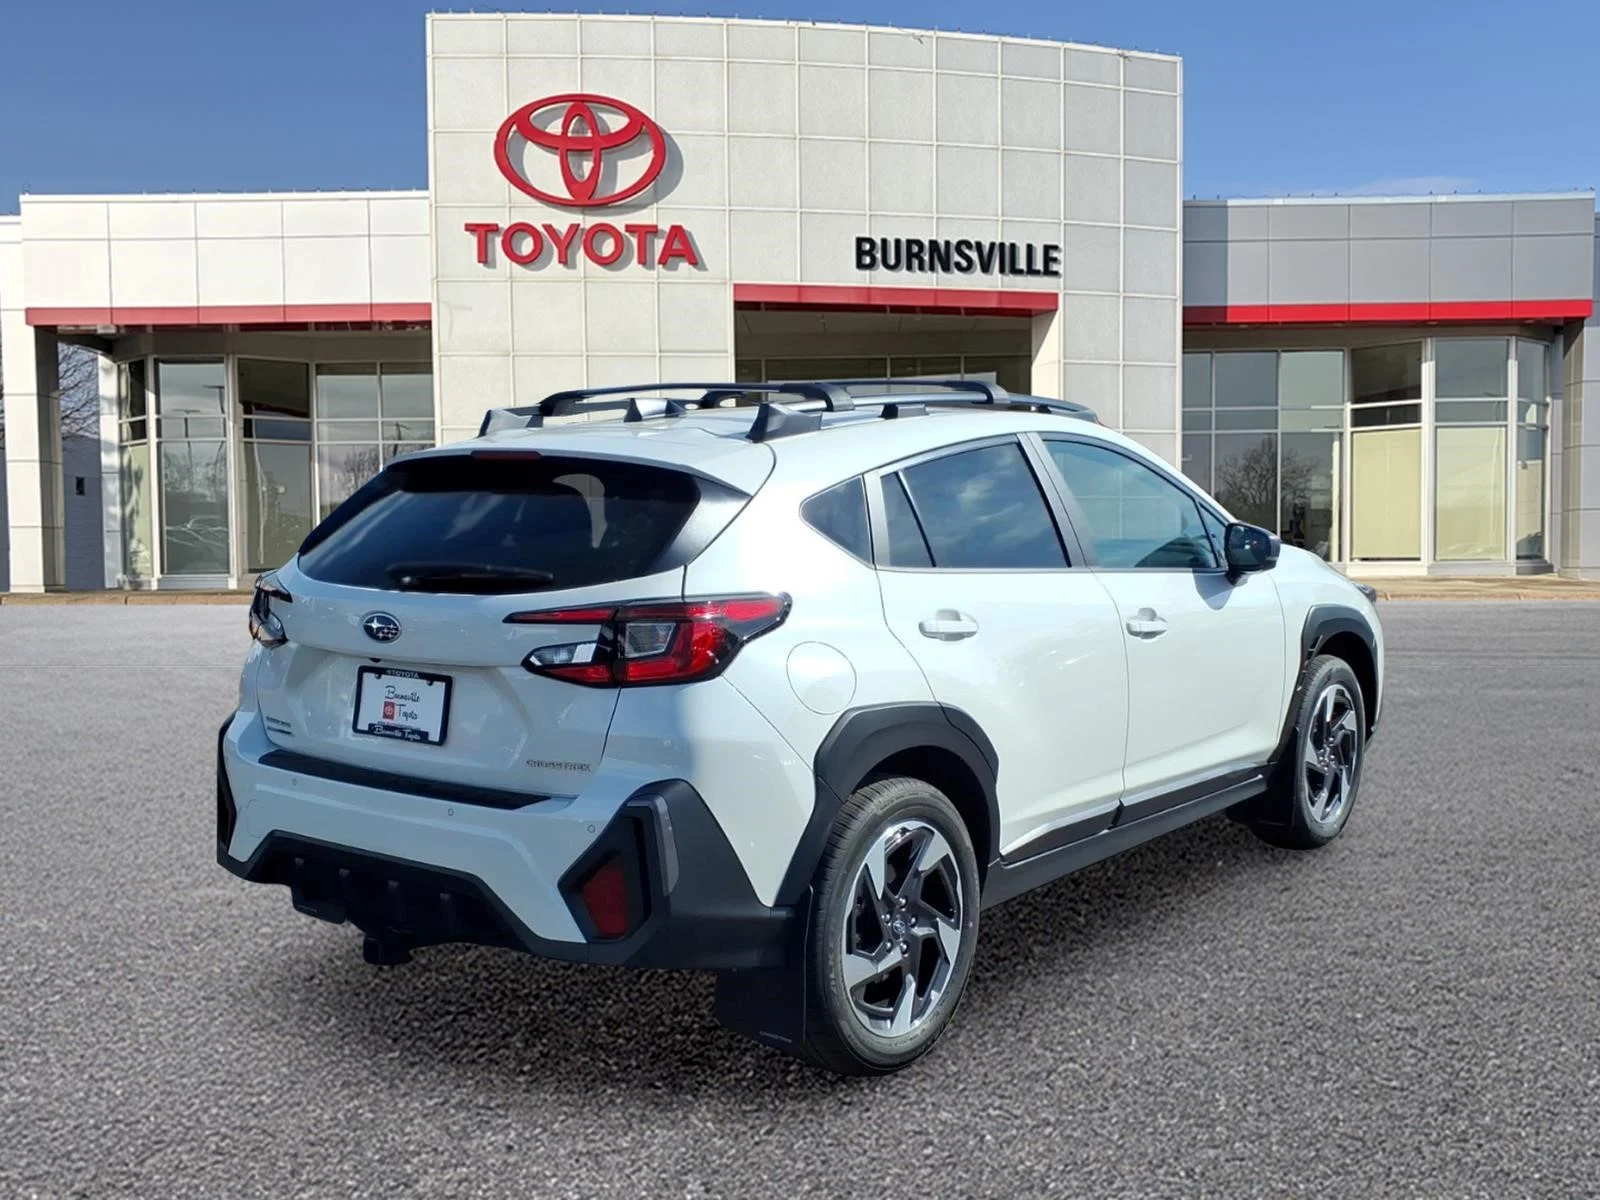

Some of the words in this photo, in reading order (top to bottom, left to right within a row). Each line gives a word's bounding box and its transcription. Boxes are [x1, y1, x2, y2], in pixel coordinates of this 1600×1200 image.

[464, 222, 698, 266] TOYOTA
[855, 236, 1061, 277] BURNSVILLE
[391, 669, 419, 678] TOYOTA
